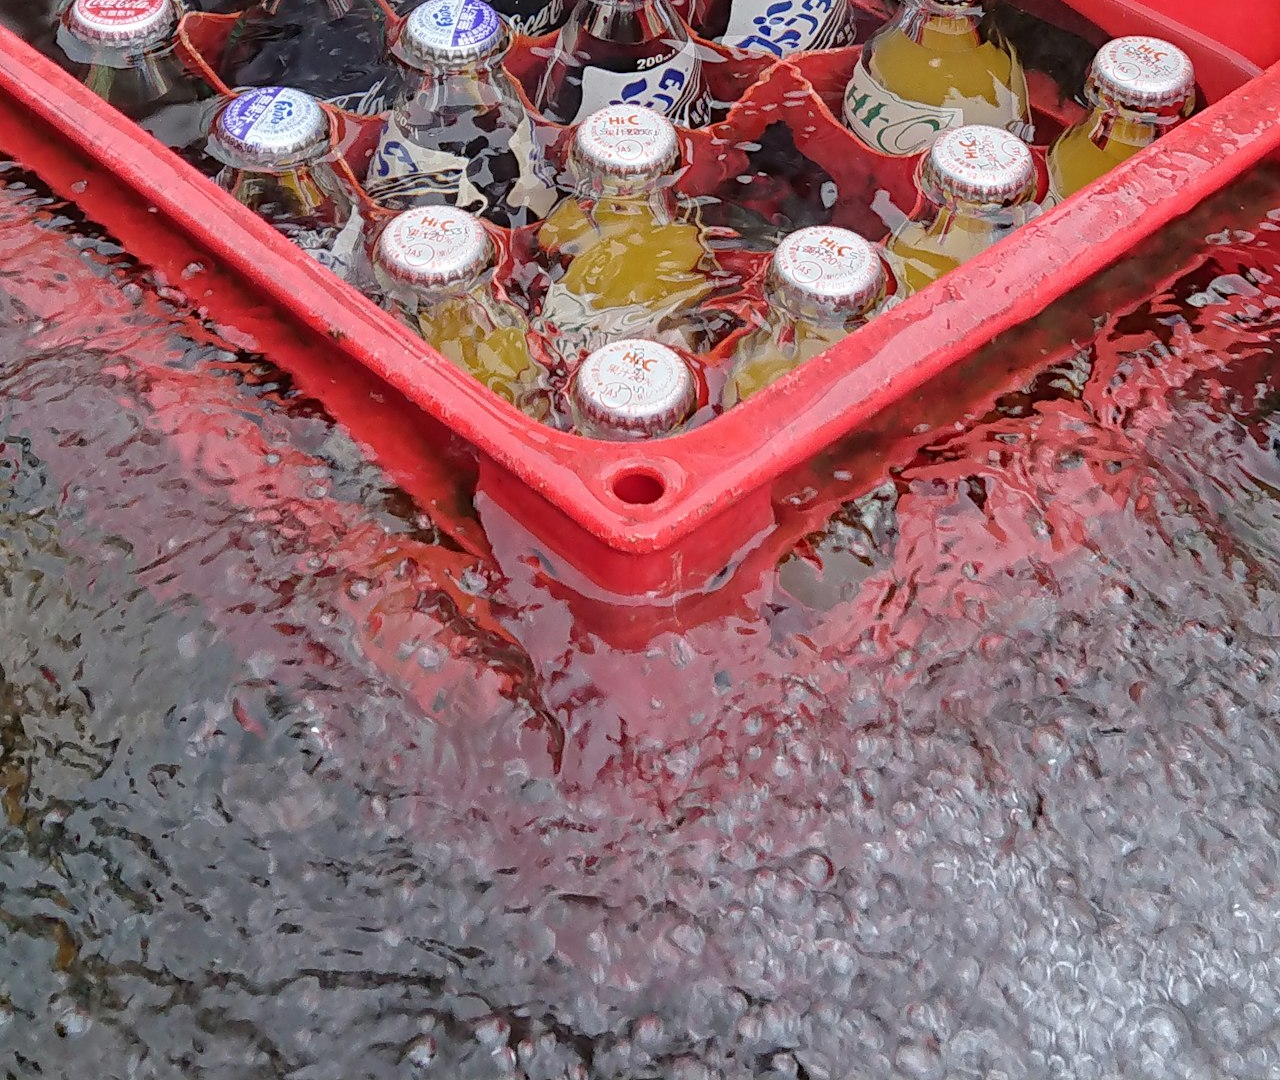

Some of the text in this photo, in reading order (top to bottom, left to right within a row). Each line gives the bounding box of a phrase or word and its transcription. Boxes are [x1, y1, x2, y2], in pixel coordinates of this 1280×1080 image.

[435, 5, 455, 27] Fanta
[270, 100, 294, 125] Fanta
[405, 248, 423, 258] JAS
[794, 264, 812, 276] JAS
[601, 385, 619, 399] JAS
